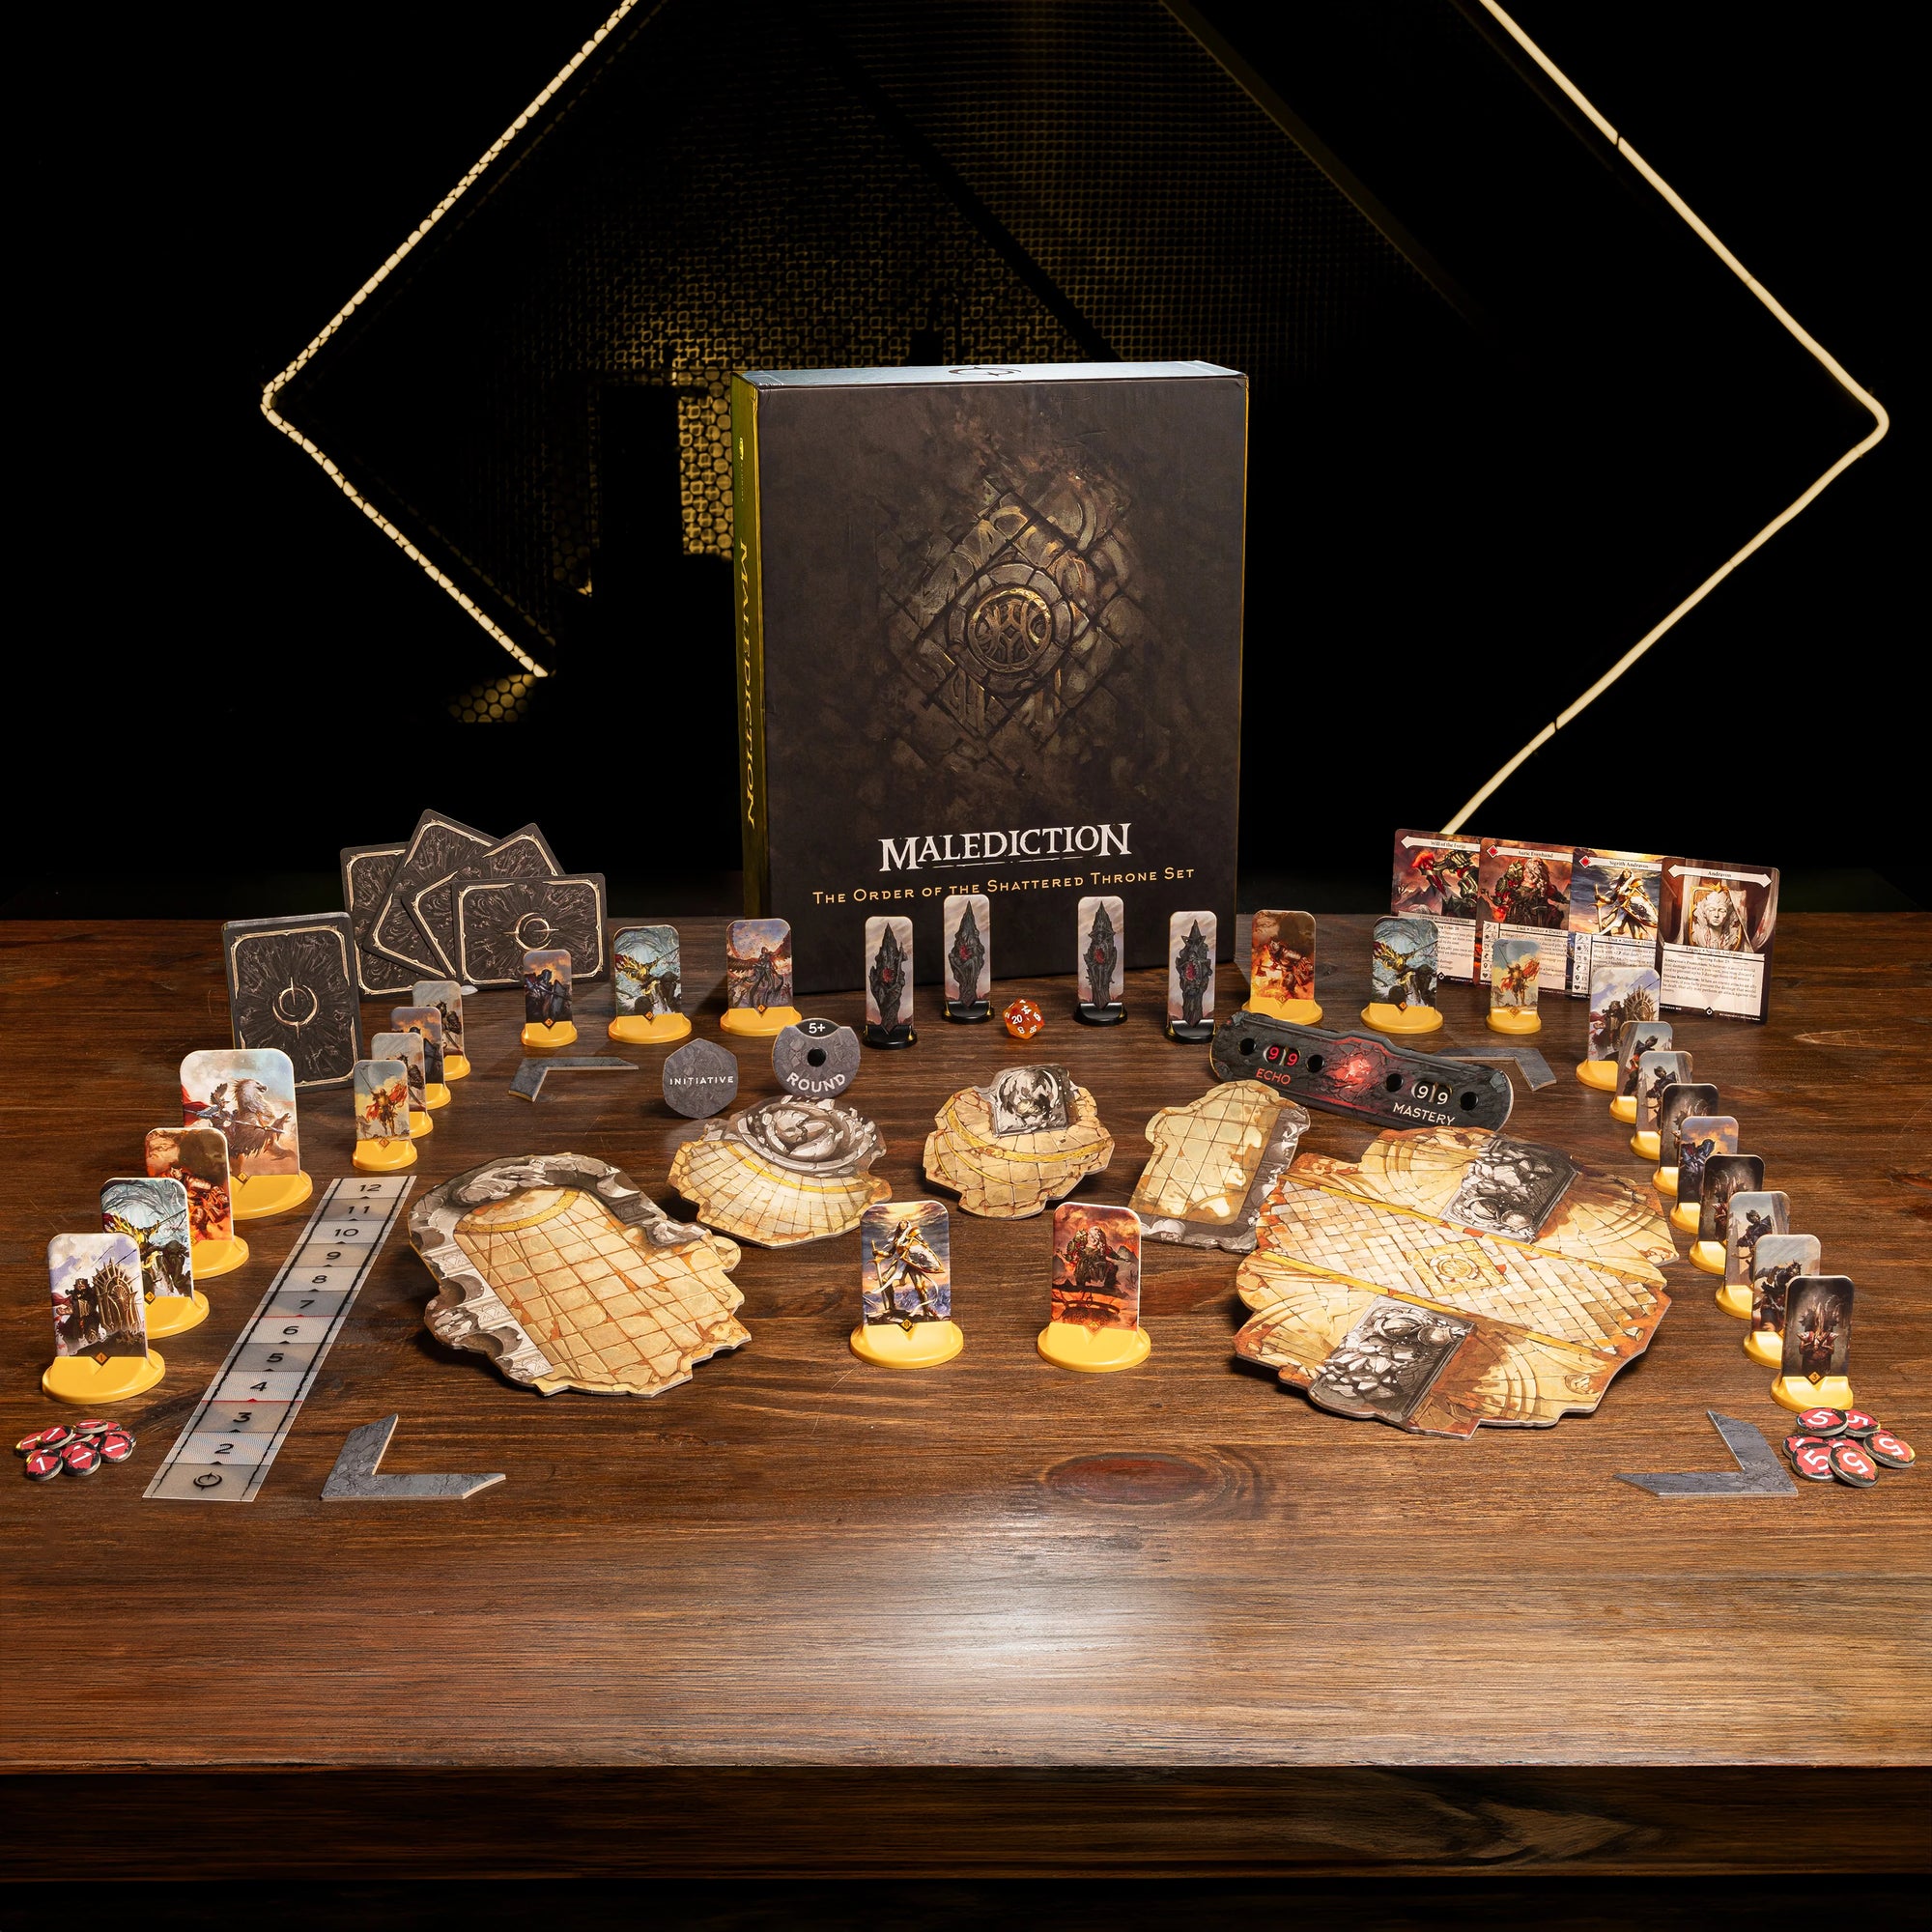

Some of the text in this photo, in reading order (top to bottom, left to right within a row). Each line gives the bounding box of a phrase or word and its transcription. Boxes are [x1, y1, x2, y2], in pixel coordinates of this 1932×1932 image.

[739, 541, 755, 830] MALEDICTION
[878, 823, 1132, 871] MALEDICTION
[1011, 1014, 1023, 1025] 20
[809, 1022, 826, 1034] 5+
[1268, 1046, 1298, 1066] 9 9
[669, 1075, 734, 1086] INITIATIVE
[786, 1071, 846, 1093] ROUND
[1256, 1067, 1292, 1085] ECHO
[1416, 1085, 1448, 1105] 9 9
[1393, 1102, 1456, 1125] MASTERY
[359, 1183, 383, 1193] 12
[348, 1205, 370, 1214] 11
[334, 1228, 358, 1237] 10
[326, 1251, 342, 1261] 9
[311, 1274, 327, 1284] 8
[299, 1299, 315, 1309] 7
[282, 1325, 298, 1335] 6
[267, 1352, 284, 1363] 5
[250, 1381, 268, 1392] 4
[233, 1411, 252, 1423] 3
[1806, 1410, 1833, 1425] 5
[1846, 1412, 1868, 1426] 5
[214, 1443, 234, 1455] 2
[1878, 1437, 1904, 1456] 5
[71, 1452, 93, 1463] 1
[1804, 1450, 1829, 1470] 5
[1842, 1452, 1869, 1474] 5
[36, 1457, 45, 1471] 1
